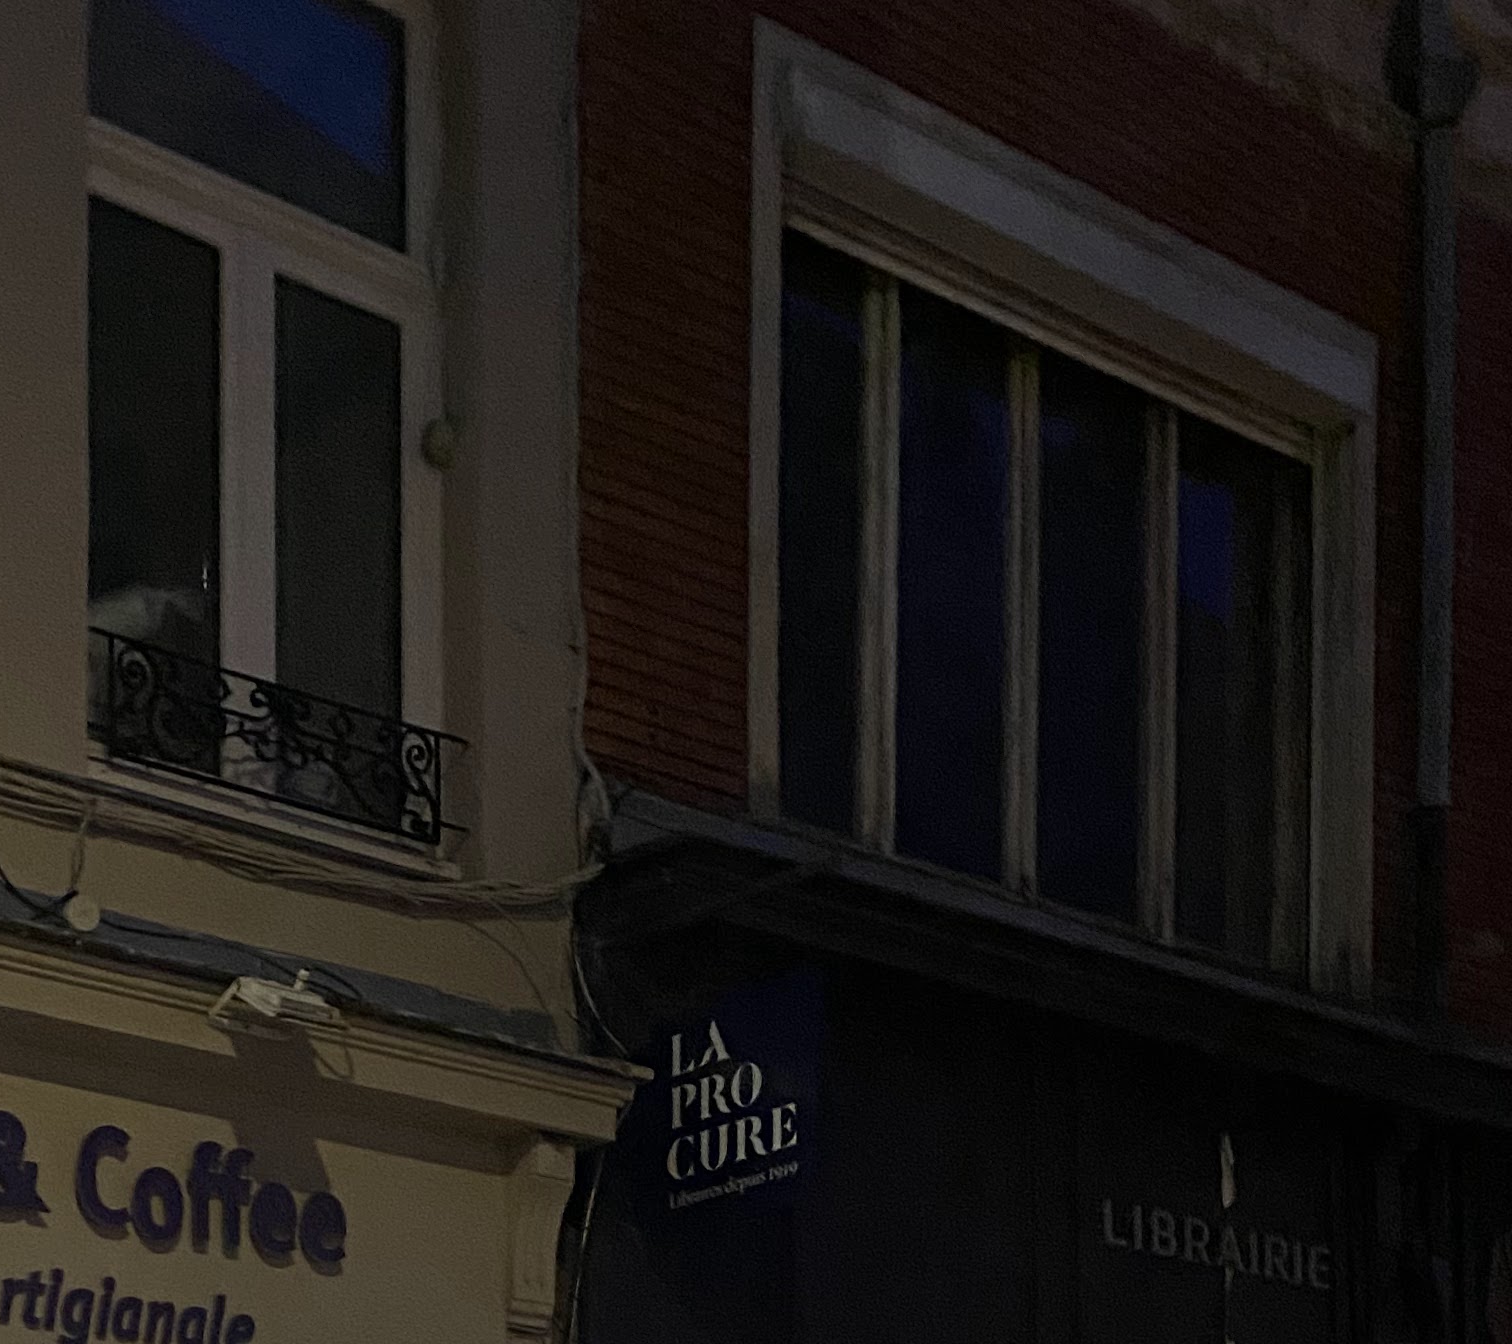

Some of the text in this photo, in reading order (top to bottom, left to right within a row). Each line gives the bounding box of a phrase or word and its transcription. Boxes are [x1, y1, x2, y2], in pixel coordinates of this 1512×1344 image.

[672, 1020, 731, 1077] LA
[672, 1062, 763, 1129] PRO
[667, 1102, 798, 1180] CURE
[75, 1124, 347, 1273] Coffee
[1102, 1198, 1331, 1289] LIBRAIRIE
